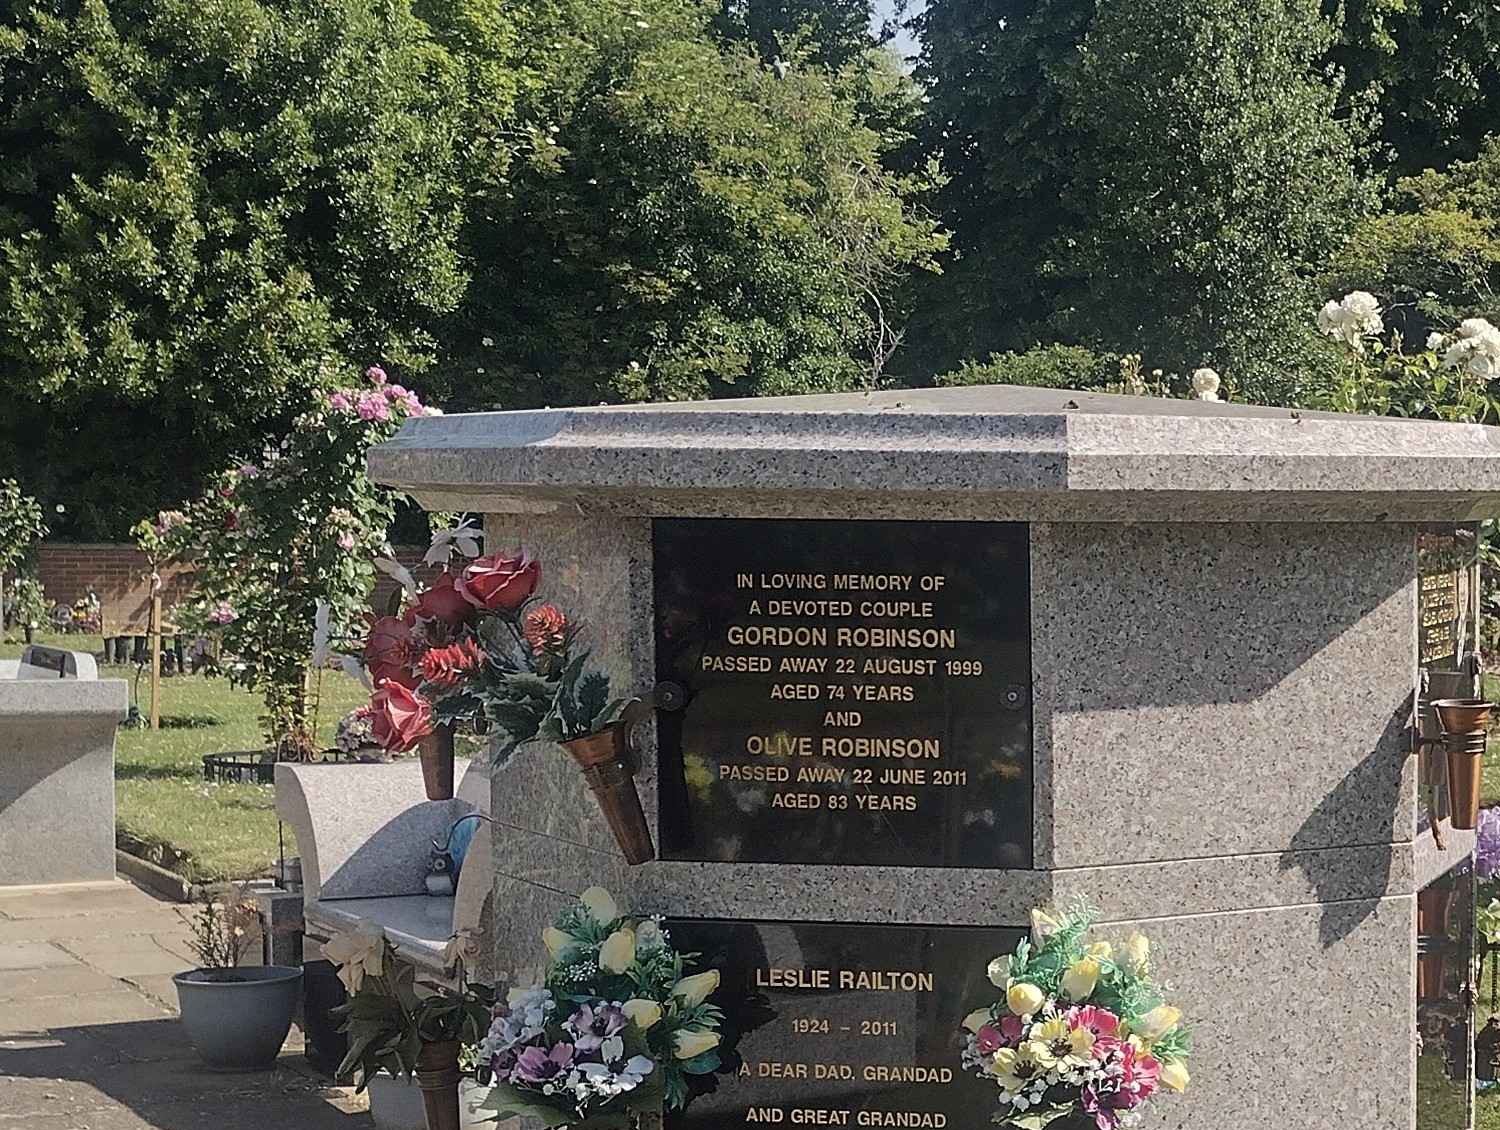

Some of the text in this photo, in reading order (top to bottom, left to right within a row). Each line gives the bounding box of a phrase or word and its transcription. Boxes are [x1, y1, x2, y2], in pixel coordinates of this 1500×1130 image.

[736, 573, 946, 592] IN LOVING MEMORY OF
[748, 599, 934, 618] A DEVOTED COUPLE
[727, 626, 956, 649] GORDON ROBINSON
[701, 656, 983, 676] PASSED AWAY 22 AUGUST 1999
[770, 684, 915, 702] AGED 74 YEARS
[823, 711, 862, 727] AND
[746, 736, 941, 759] OLIVE ROBINSON
[719, 765, 968, 786] PASSED AWAY 22 JUNE 2011
[771, 793, 918, 812] AGED 83 YEARS
[756, 968, 934, 992] LESLIE RAILTON
[791, 1018, 830, 1035] 1924
[860, 1020, 898, 1036] 2011
[738, 1062, 752, 1078] A
[758, 1062, 808, 1080] DEAR
[863, 1065, 953, 1084] GRANDAD
[745, 1107, 947, 1129] AND GREAT GRANDAD
